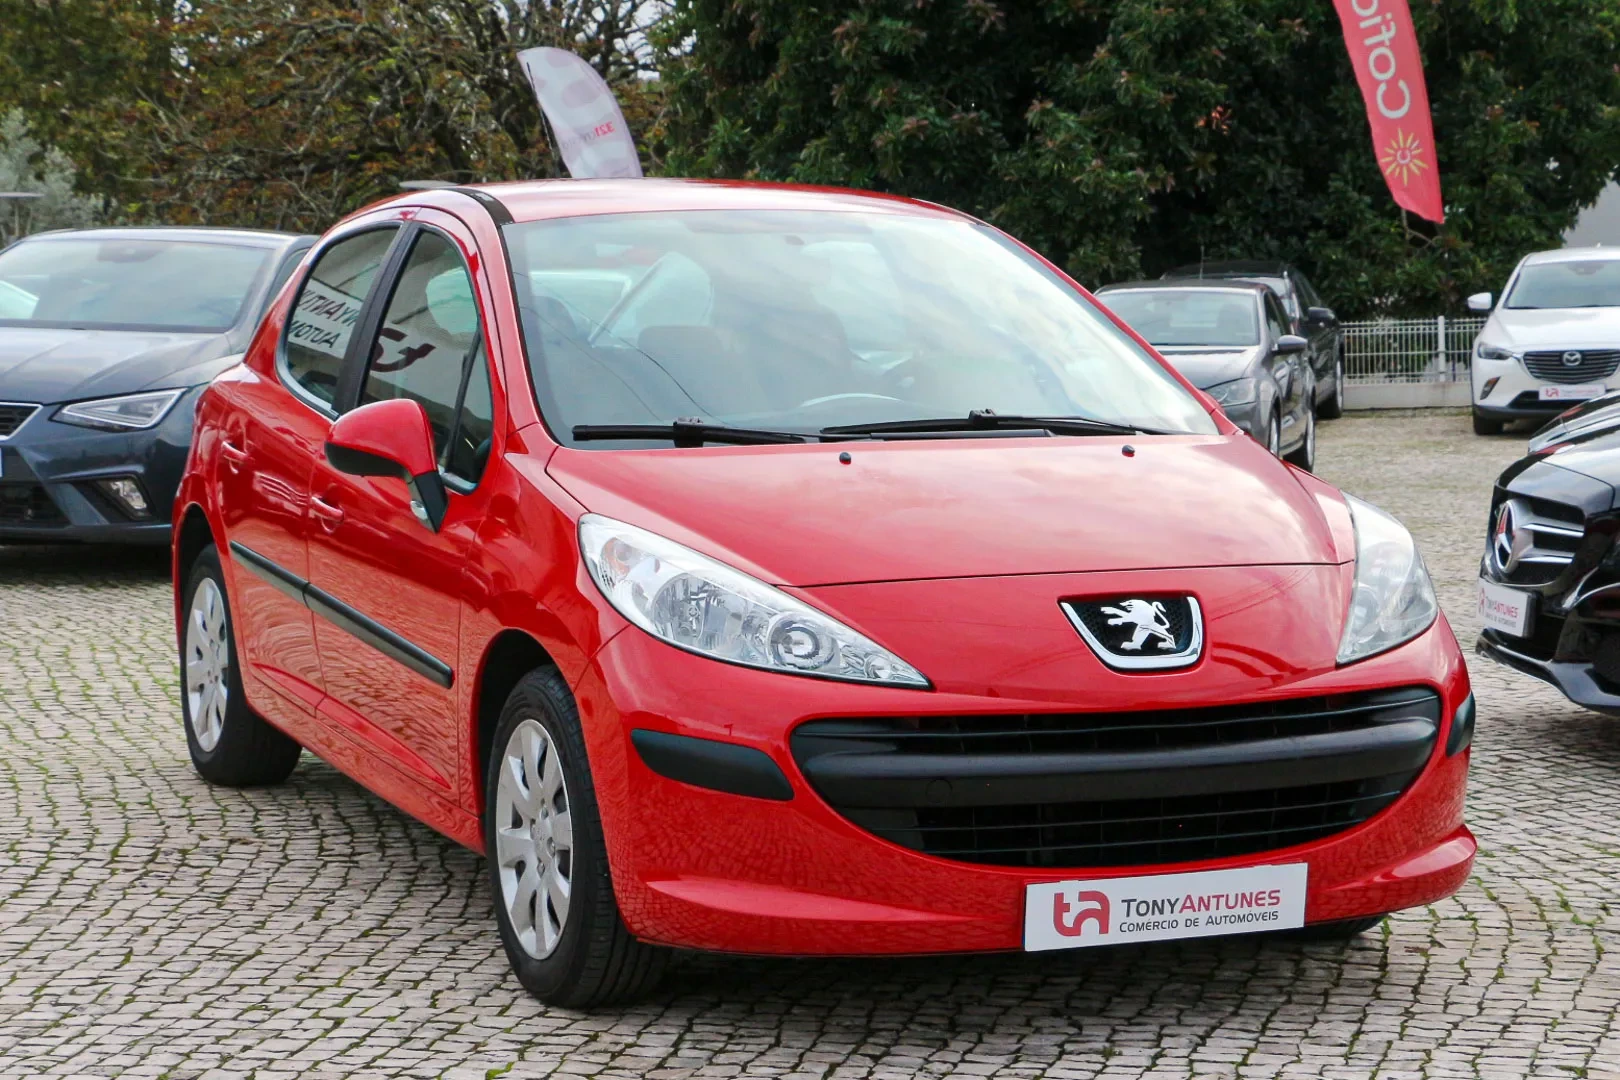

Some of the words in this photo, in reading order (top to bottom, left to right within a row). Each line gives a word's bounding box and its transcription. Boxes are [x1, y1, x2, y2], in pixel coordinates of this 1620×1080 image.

[1119, 917, 1179, 933] COMÉRCIO
[1185, 917, 1200, 929] DE
[1205, 909, 1279, 927] AUTOMÓVEIS
